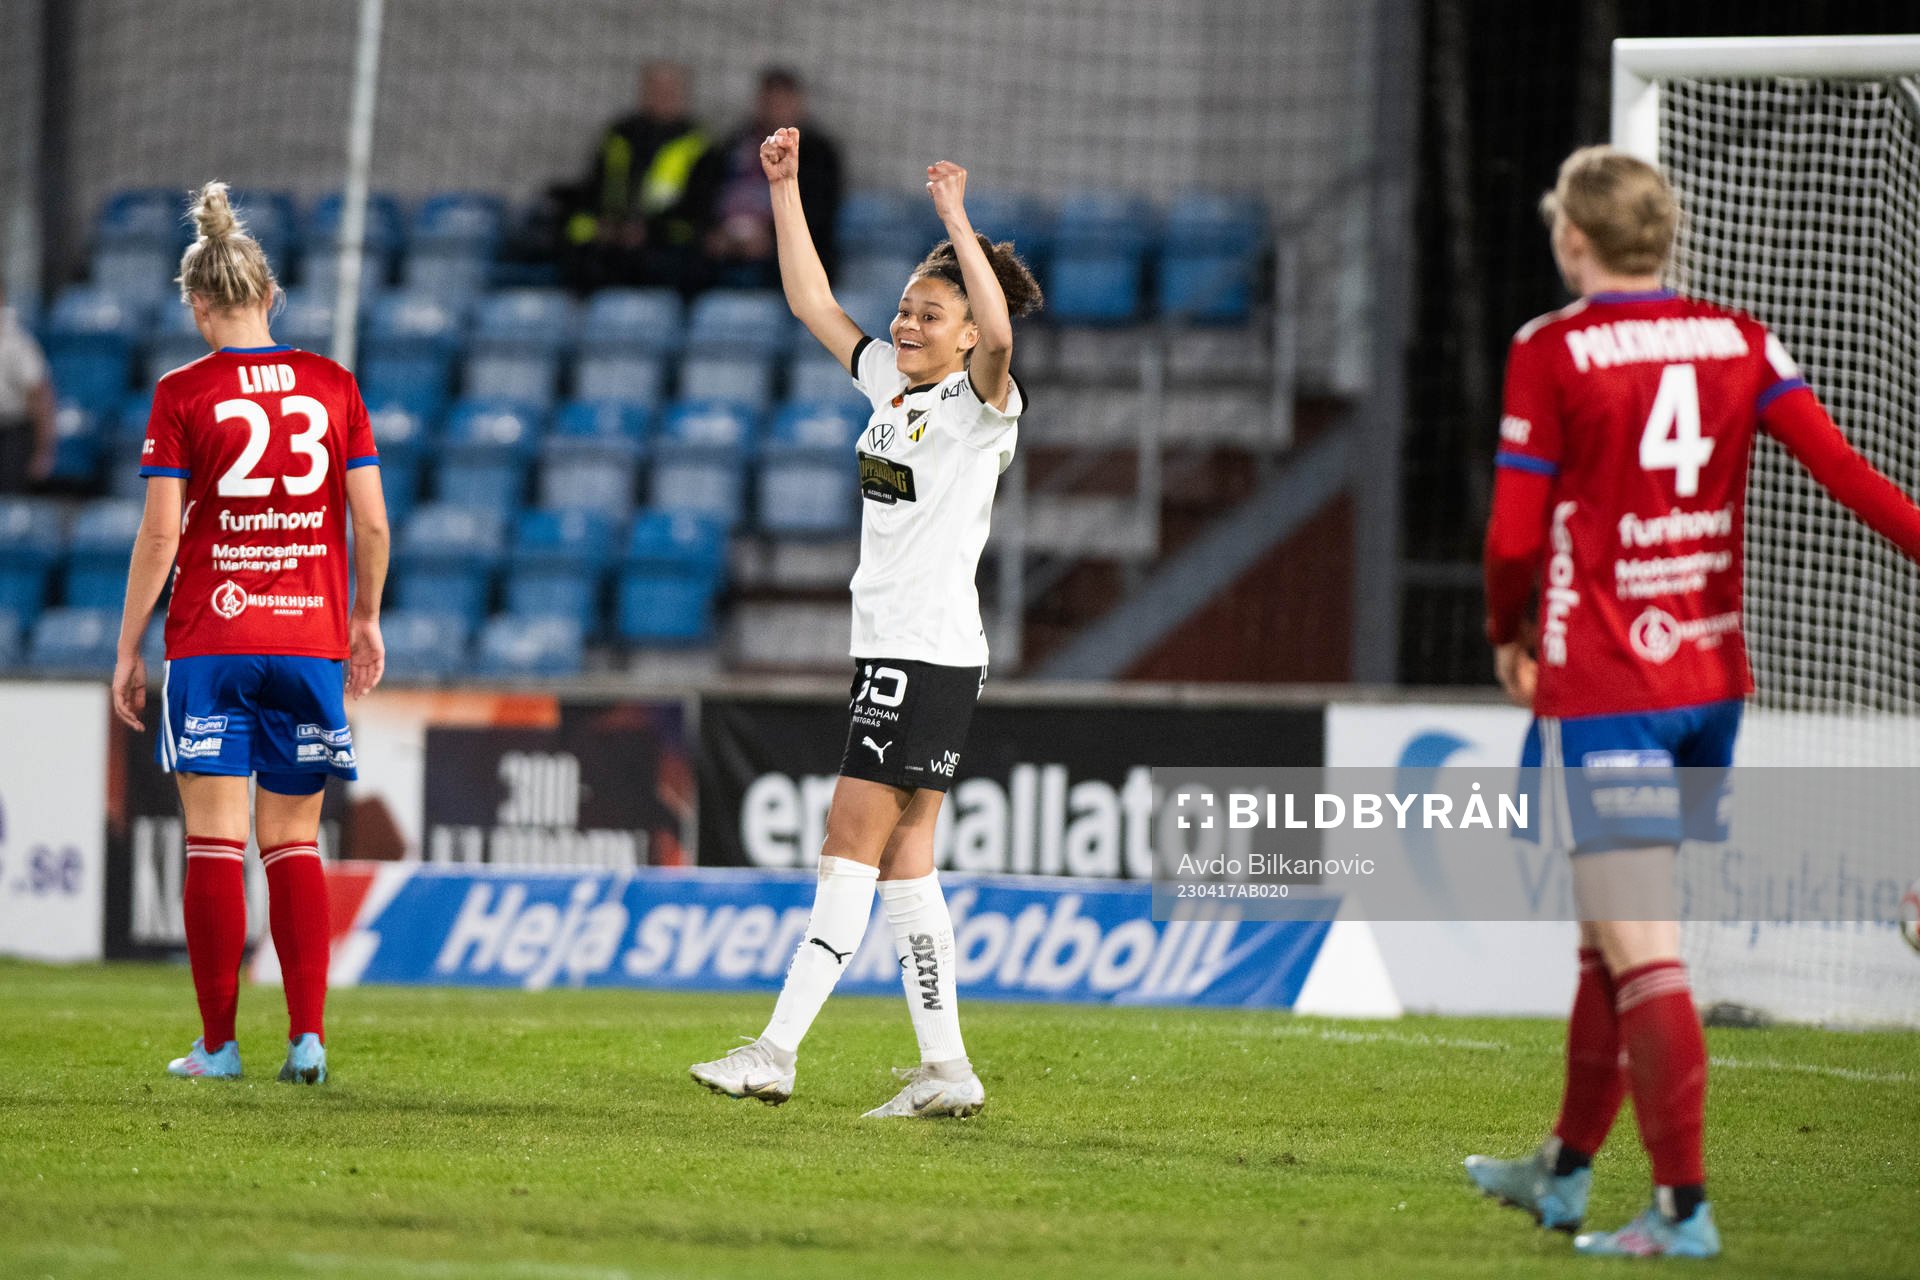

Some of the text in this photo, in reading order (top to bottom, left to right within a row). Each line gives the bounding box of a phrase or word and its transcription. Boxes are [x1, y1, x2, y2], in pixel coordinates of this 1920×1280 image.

[237, 363, 296, 394] LIND
[1638, 362, 1716, 497] 4
[214, 394, 330, 497] 23
[219, 506, 325, 532] furninova
[212, 543, 328, 559] Motorcentrum
[220, 559, 281, 573] Markaryd
[282, 557, 298, 570] AB
[247, 593, 325, 608] MUSIKHUSET
[864, 706, 900, 722] JOHAN
[738, 762, 1270, 887] eallator
[436, 878, 629, 991] Heja
[622, 893, 904, 982] svenk
[908, 933, 943, 1010] MAXXIS
